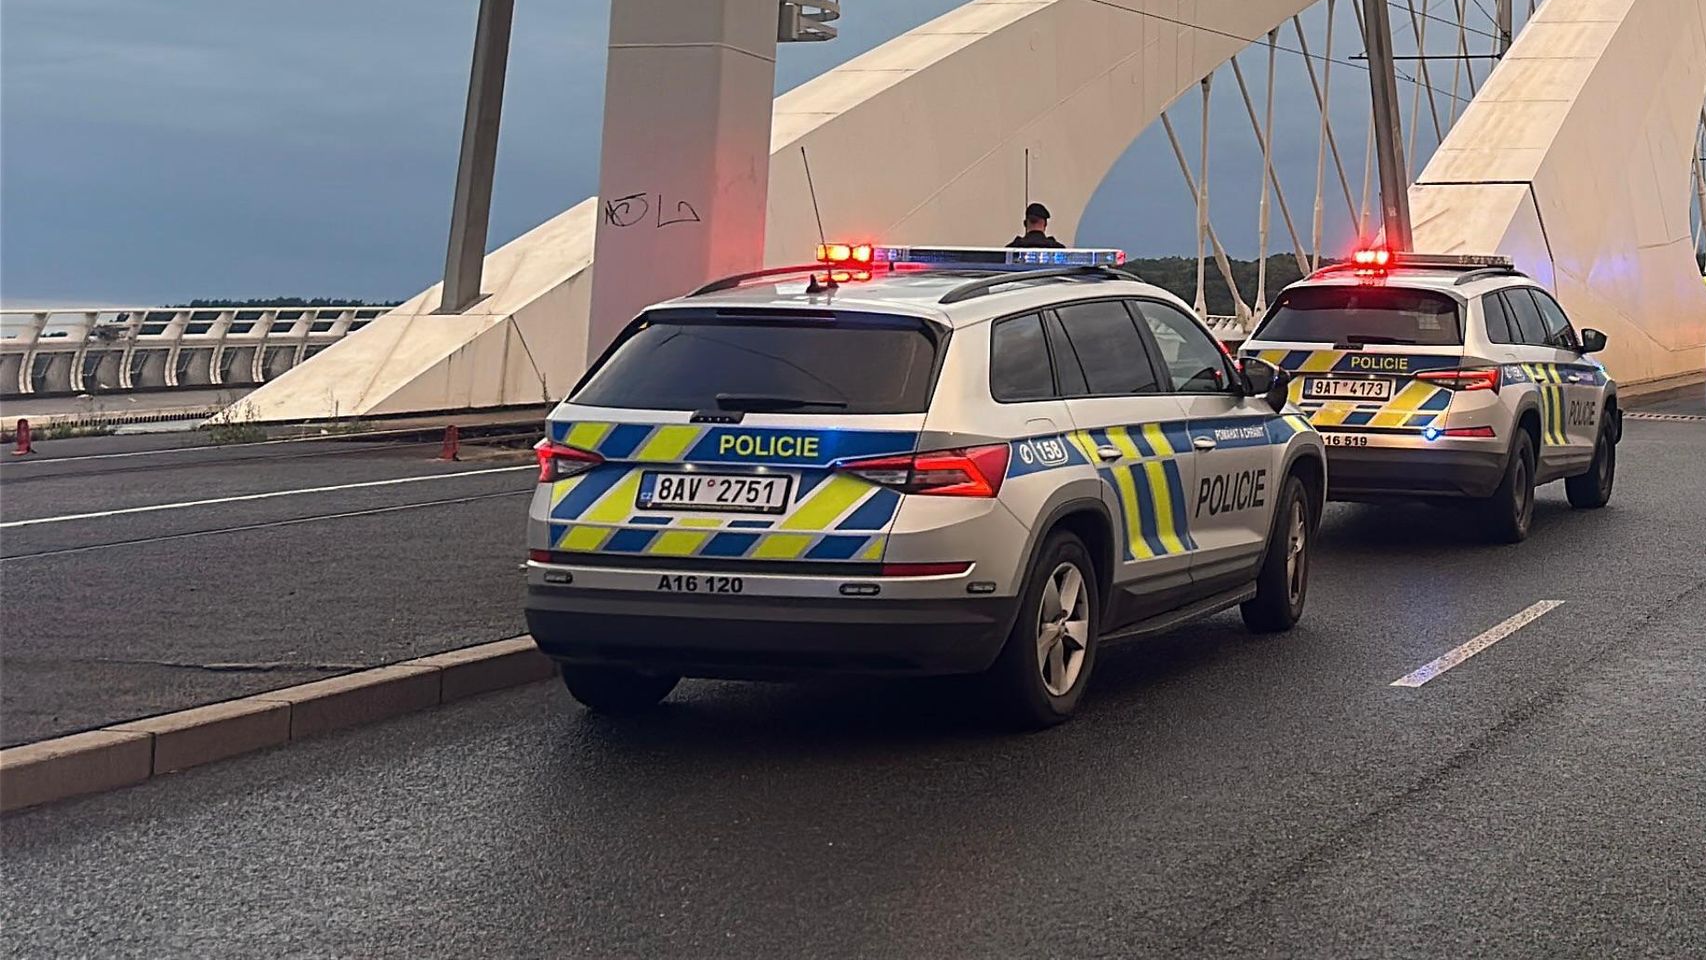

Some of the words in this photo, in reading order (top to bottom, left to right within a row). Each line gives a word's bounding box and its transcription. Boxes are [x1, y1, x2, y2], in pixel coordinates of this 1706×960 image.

[1351, 356, 1408, 370] POLICIE
[1315, 381, 1340, 394] 9AT
[1350, 382, 1383, 396] 4173
[719, 434, 819, 457] POLICIE
[1035, 439, 1063, 461] 158
[1344, 436, 1368, 446] 519
[658, 477, 702, 502] 8AV
[716, 480, 775, 504] 2751
[1195, 469, 1266, 518] POLICIE
[657, 575, 698, 592] A16
[705, 576, 743, 593] 120
